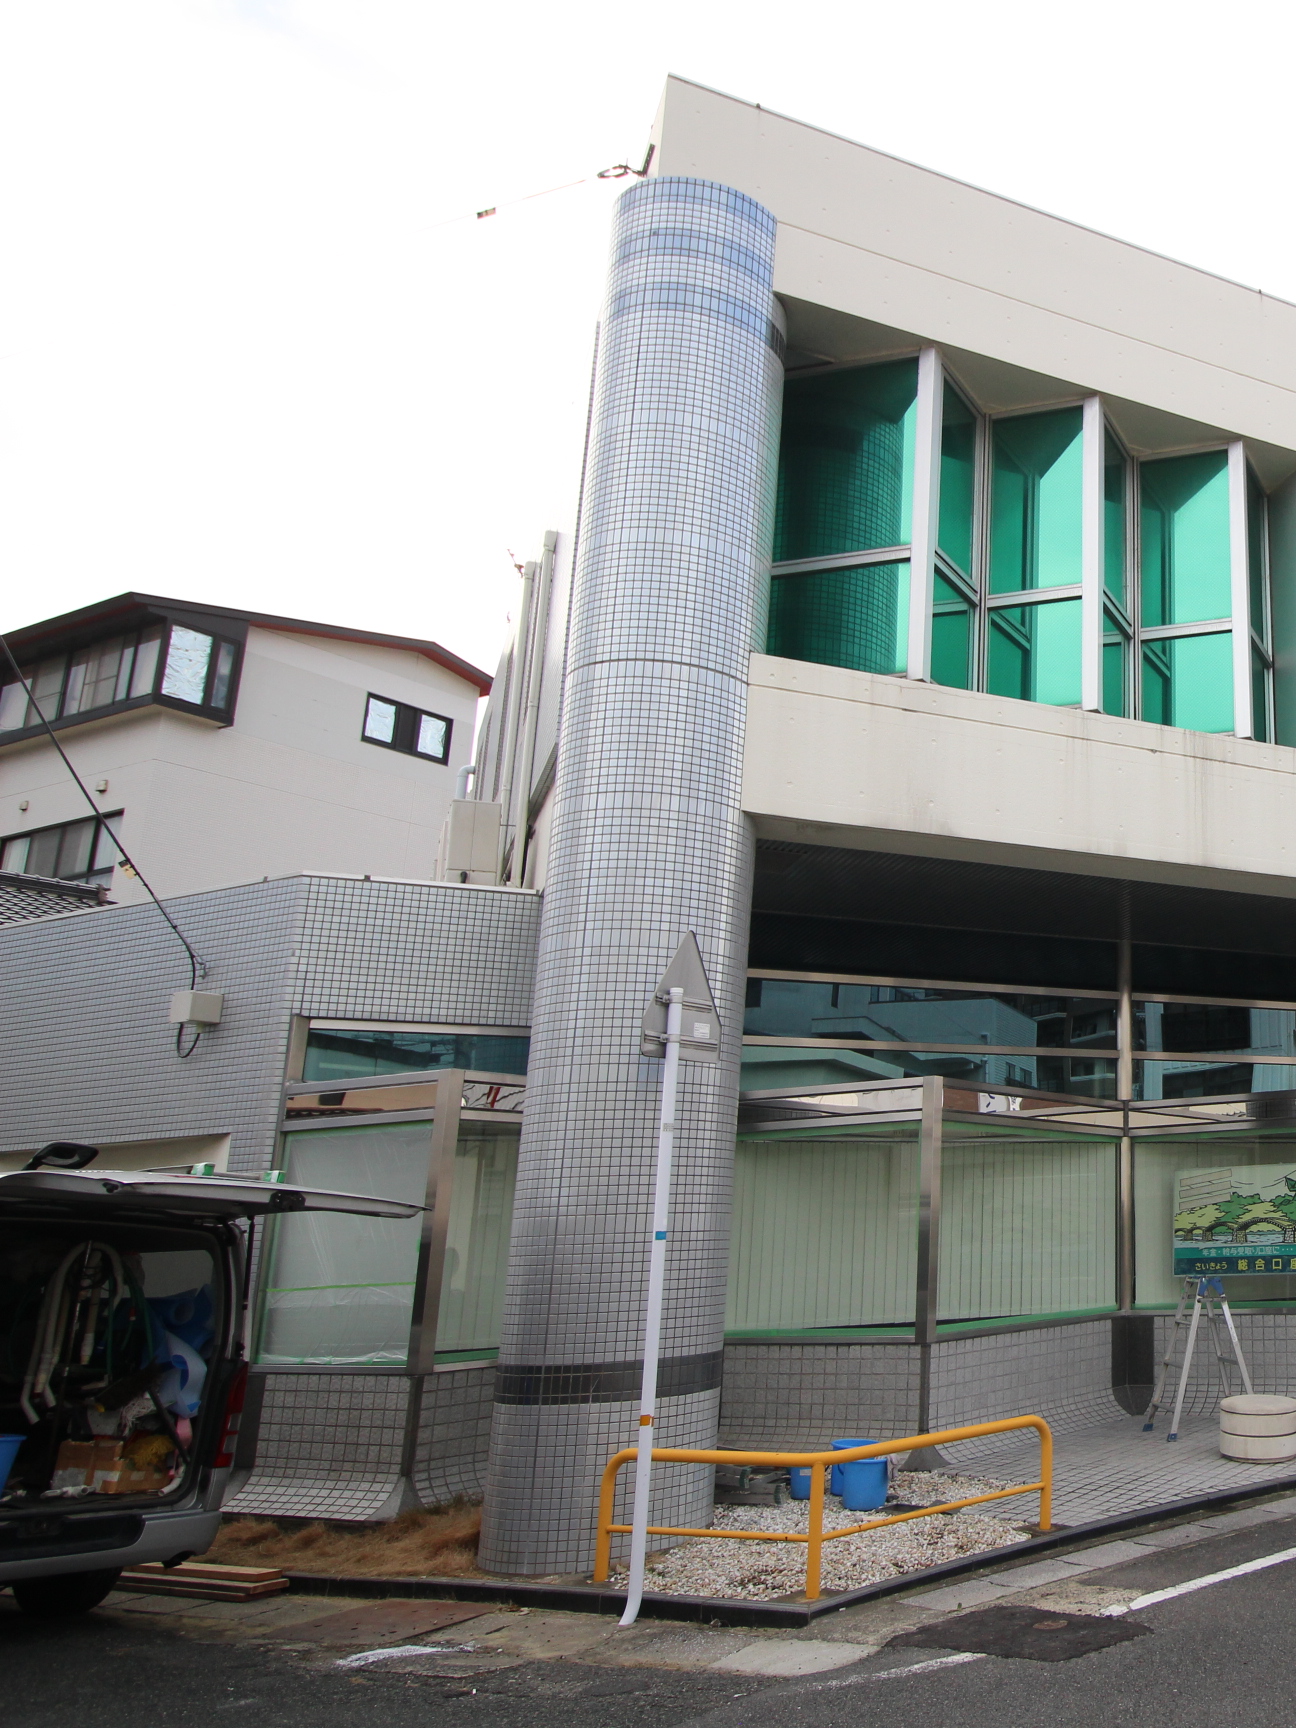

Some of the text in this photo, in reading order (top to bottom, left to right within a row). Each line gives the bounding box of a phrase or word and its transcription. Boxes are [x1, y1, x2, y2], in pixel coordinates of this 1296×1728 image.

[1194, 1261, 1228, 1271] さいきょう
